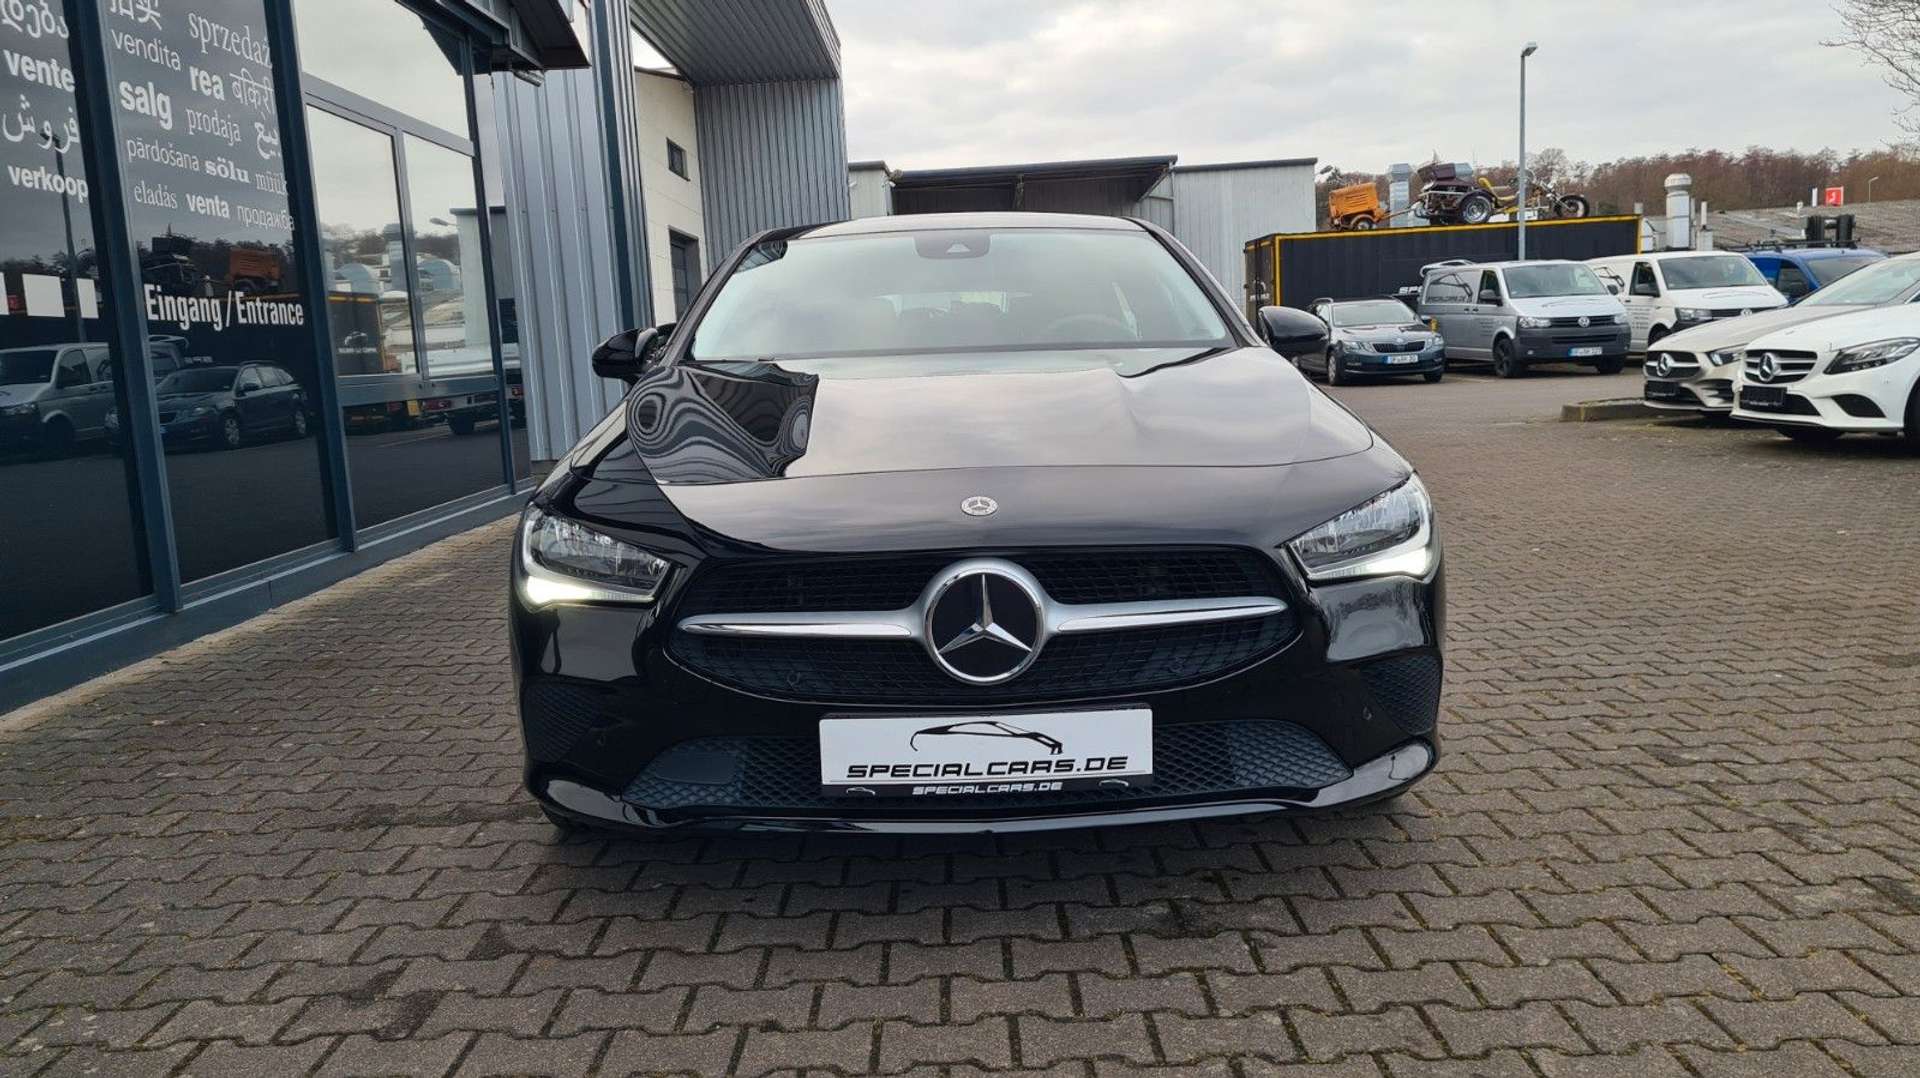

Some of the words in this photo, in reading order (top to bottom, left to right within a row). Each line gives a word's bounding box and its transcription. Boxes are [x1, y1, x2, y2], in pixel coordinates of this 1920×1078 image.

[111, 29, 182, 71] vendita
[188, 12, 273, 69] sprzedaż
[5, 50, 76, 93] vente
[189, 66, 225, 101] rea
[119, 81, 173, 131] salg
[186, 107, 241, 147] prodaja
[126, 137, 200, 171] pārdošana
[204, 157, 251, 184] sölu
[7, 165, 89, 203] verkoop
[134, 180, 178, 209] eladás
[186, 193, 230, 219] venta
[237, 205, 296, 232] продажба
[144, 283, 224, 332] Eingang
[235, 290, 305, 326] Entrance
[846, 756, 1129, 777] SPECIALCARS.DE
[912, 782, 1064, 796] SPECIALCARS.DE
